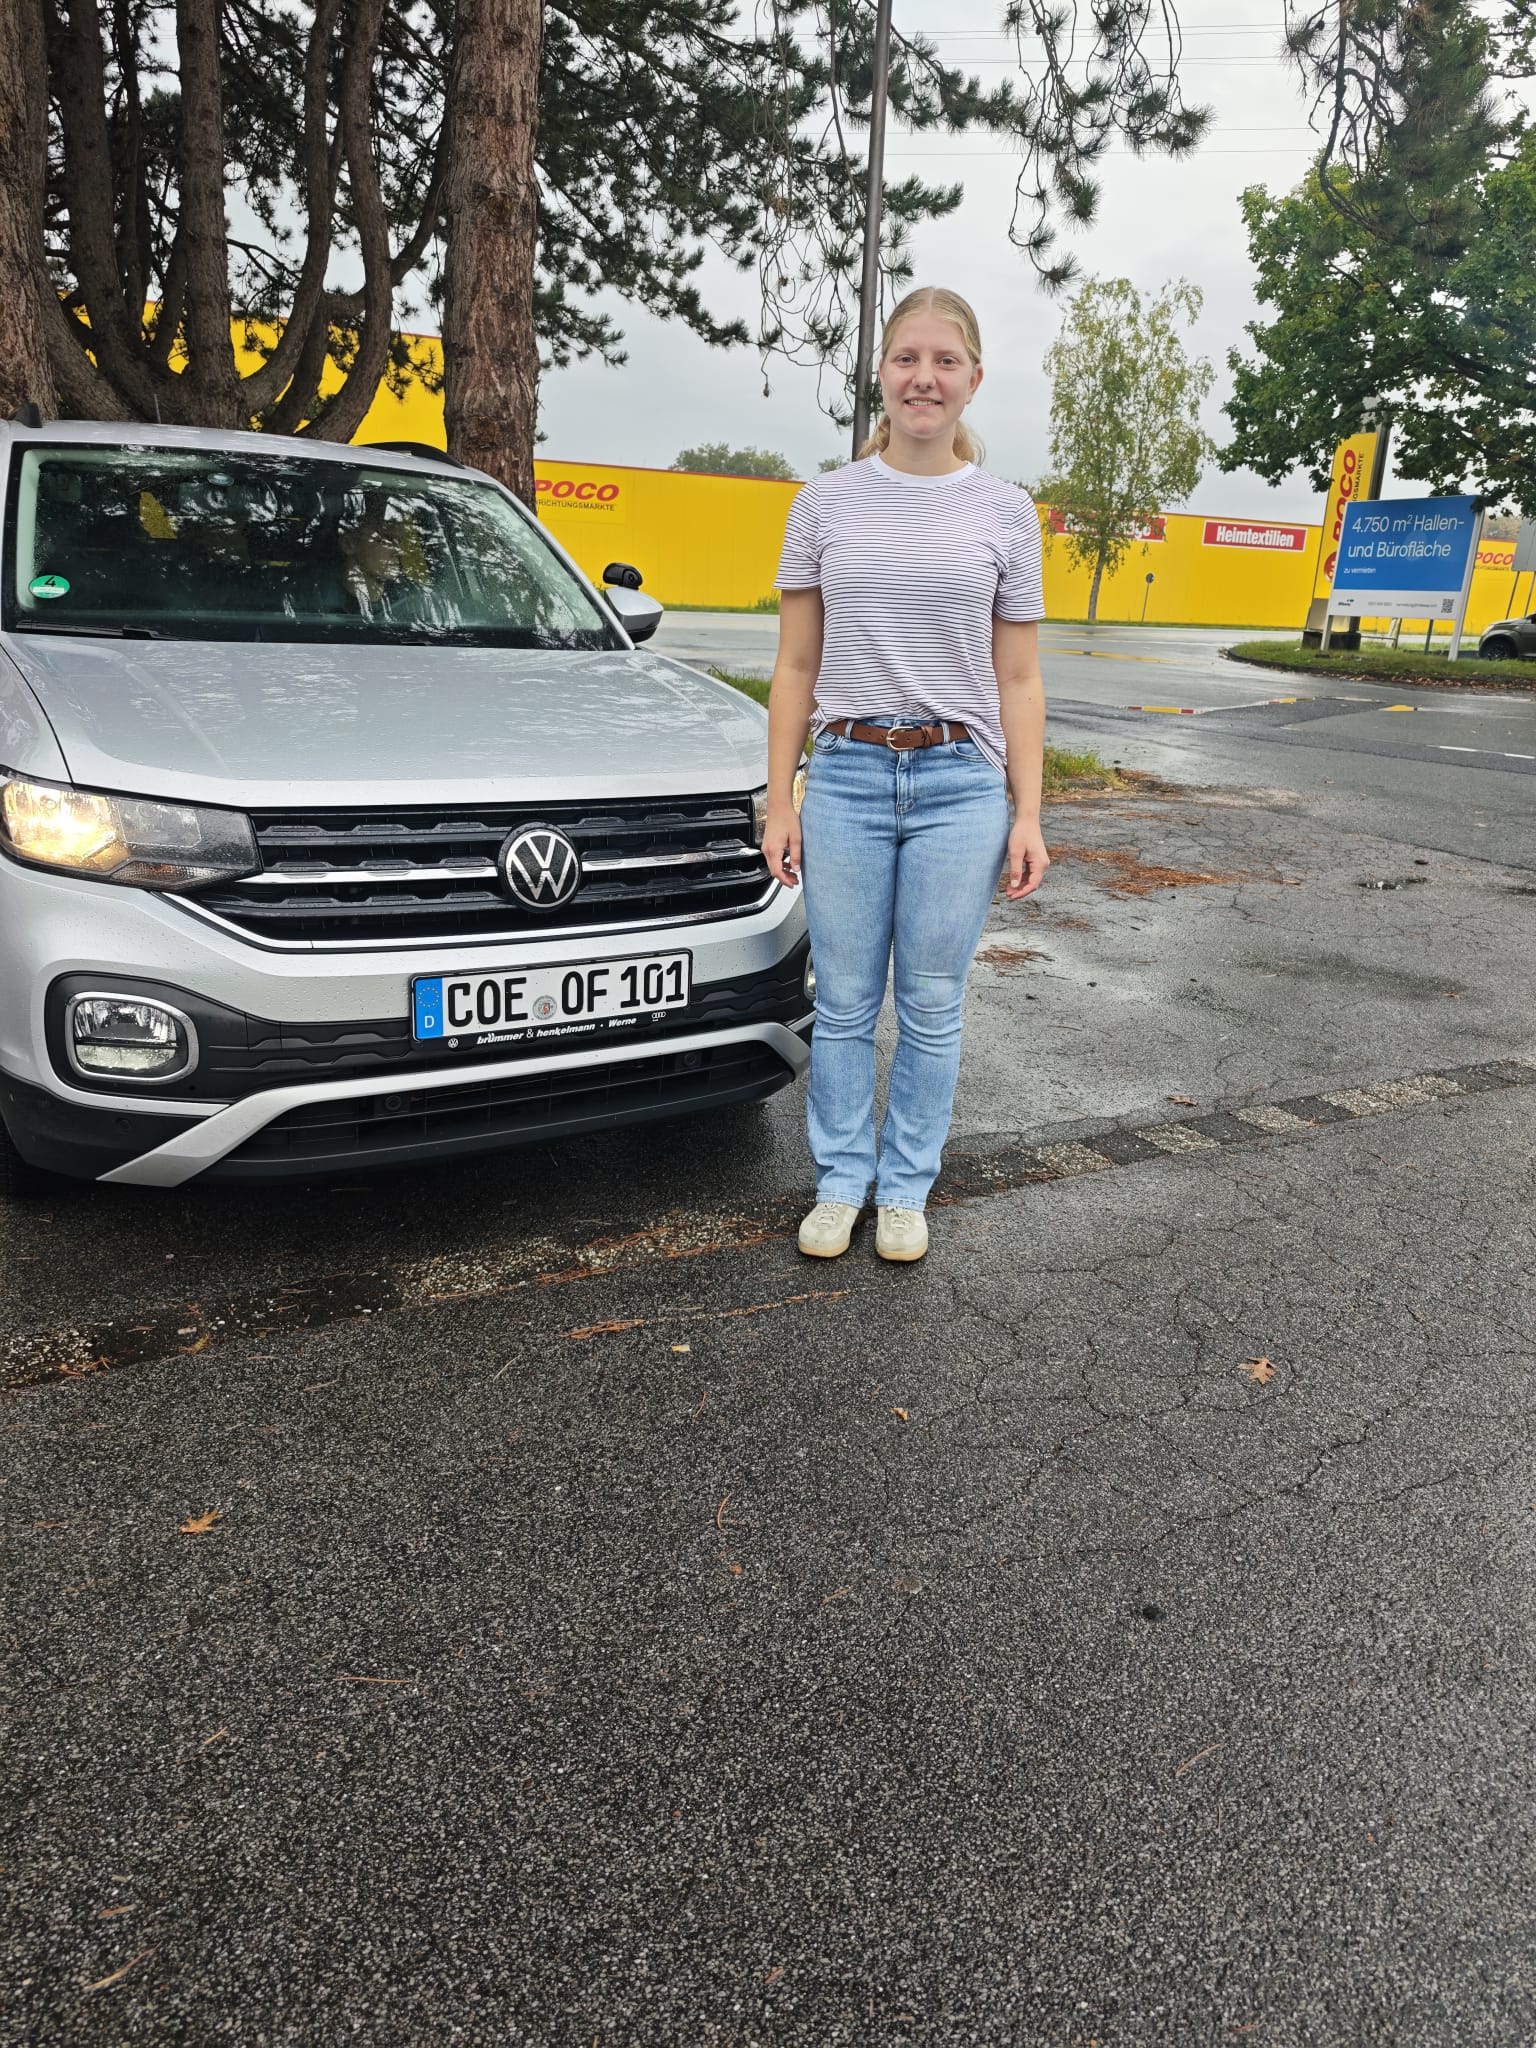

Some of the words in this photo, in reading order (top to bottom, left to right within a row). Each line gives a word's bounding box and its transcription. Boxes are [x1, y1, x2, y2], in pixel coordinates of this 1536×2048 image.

[535, 480, 619, 501] POCO
[1352, 516, 1389, 533] 4.750
[1414, 514, 1464, 531] Hallen-
[1216, 525, 1295, 547] Heimtextilien
[1348, 542, 1374, 557] und
[1376, 540, 1451, 558] Bürofläche
[44, 576, 57, 587] 4
[447, 977, 529, 1028] COE
[561, 968, 609, 1015] OF
[620, 960, 685, 1009] 101
[424, 1015, 435, 1029] D
[476, 1032, 524, 1045] brümmer
[536, 1023, 596, 1037] henkelmann
[608, 1017, 637, 1028] Werne
